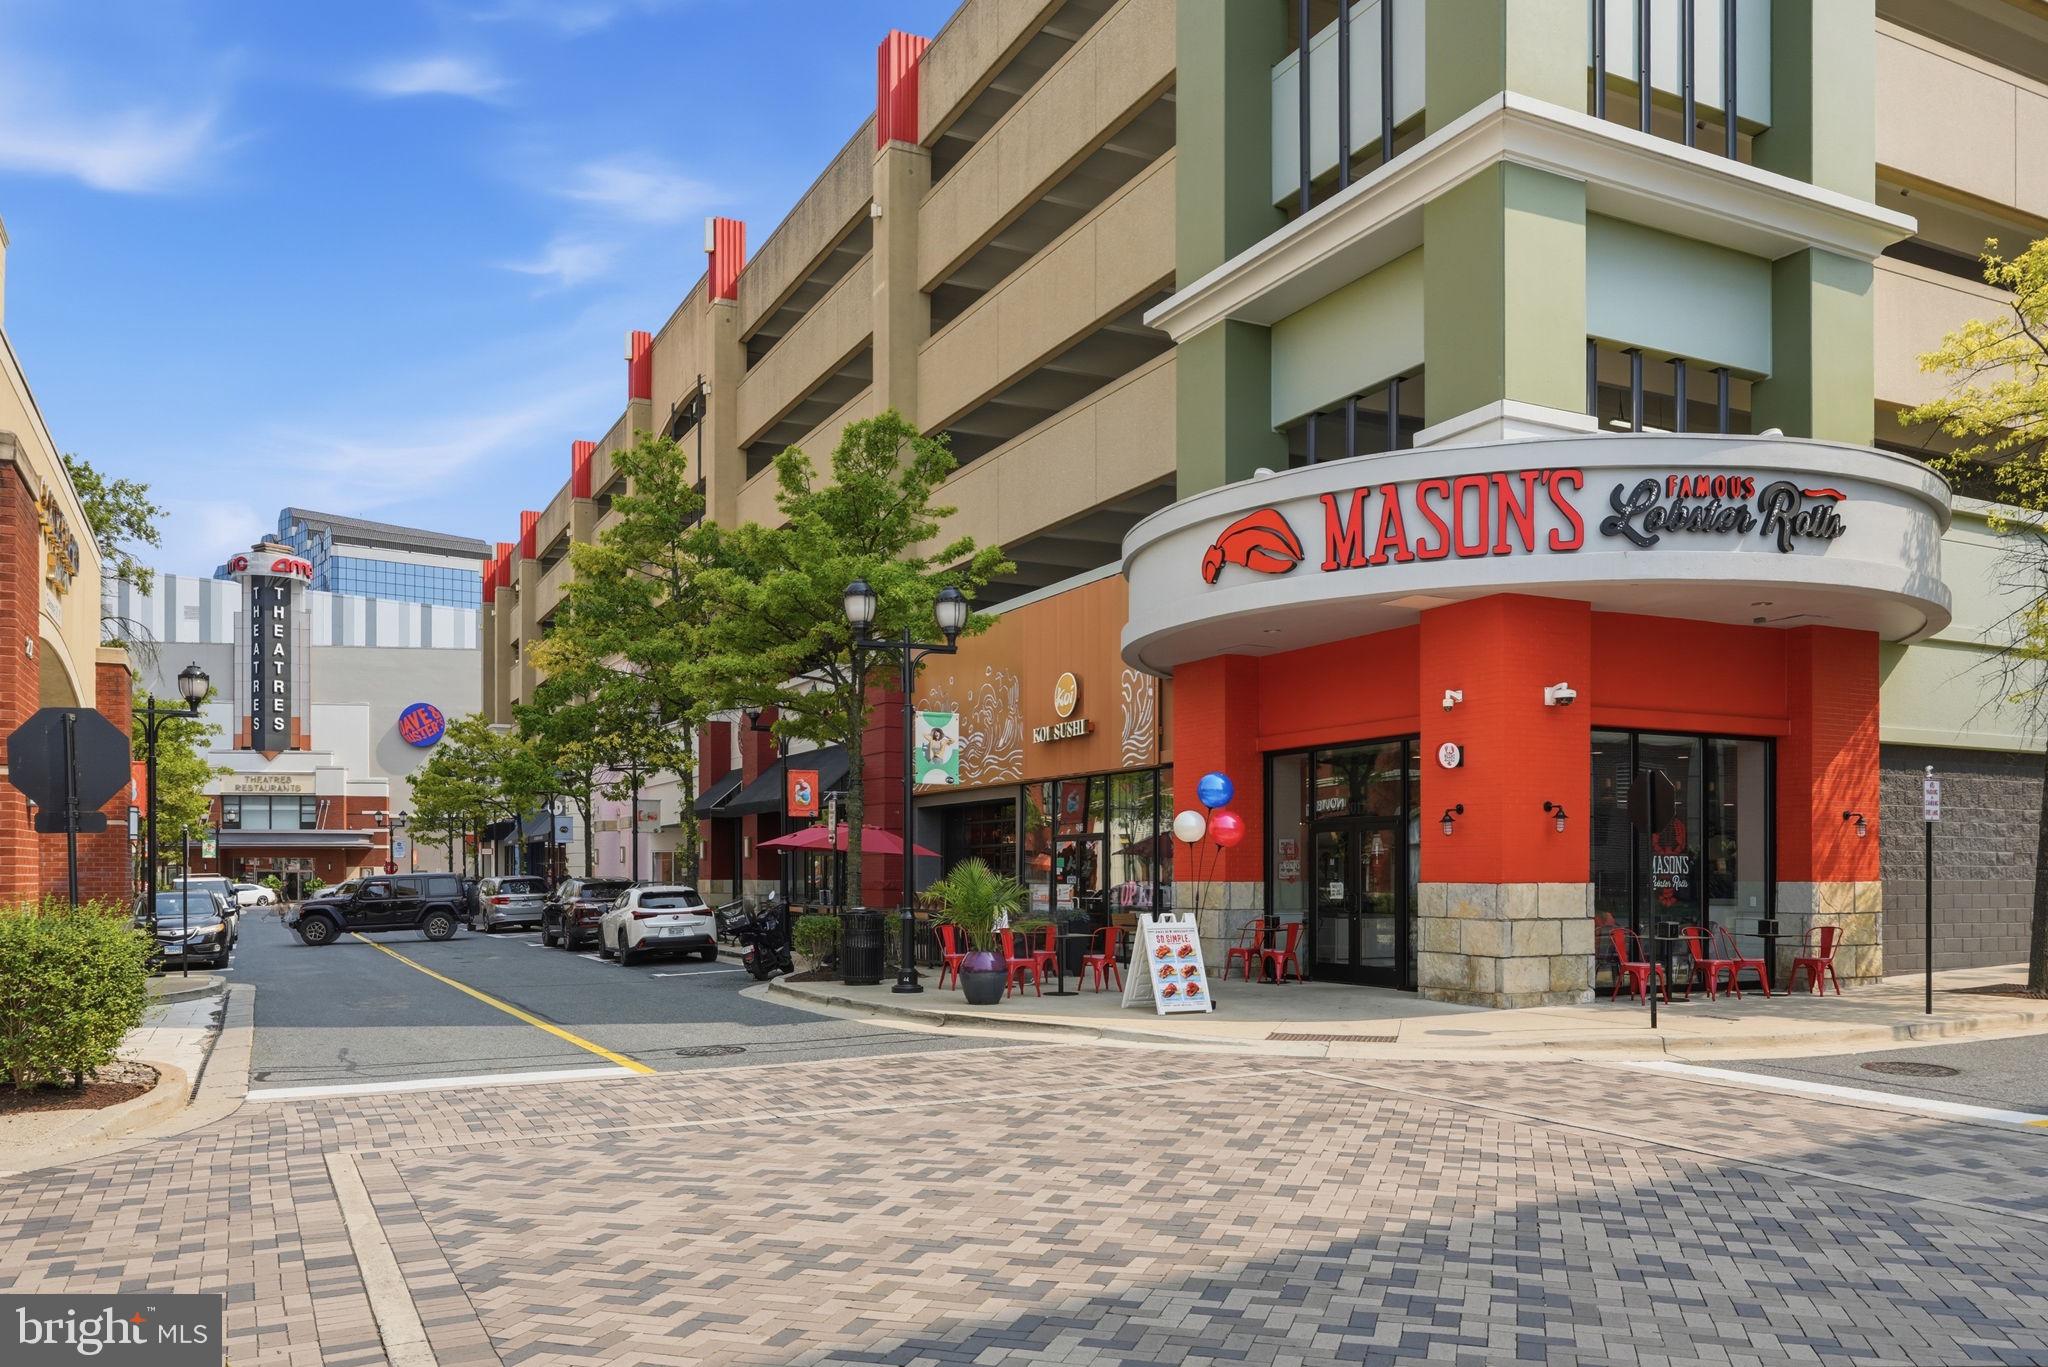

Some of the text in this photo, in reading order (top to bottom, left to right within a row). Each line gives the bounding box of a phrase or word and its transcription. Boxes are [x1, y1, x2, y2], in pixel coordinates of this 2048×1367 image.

[1666, 475, 1756, 500] FAMOUS
[1319, 467, 1585, 573] MASON'S
[1599, 478, 1848, 553] Lobster Rolls
[273, 587, 285, 730] THEATRES
[1032, 719, 1086, 743] KOI SUSHI
[234, 784, 301, 792] RESTAURANTS
[244, 775, 292, 784] THEATRES
